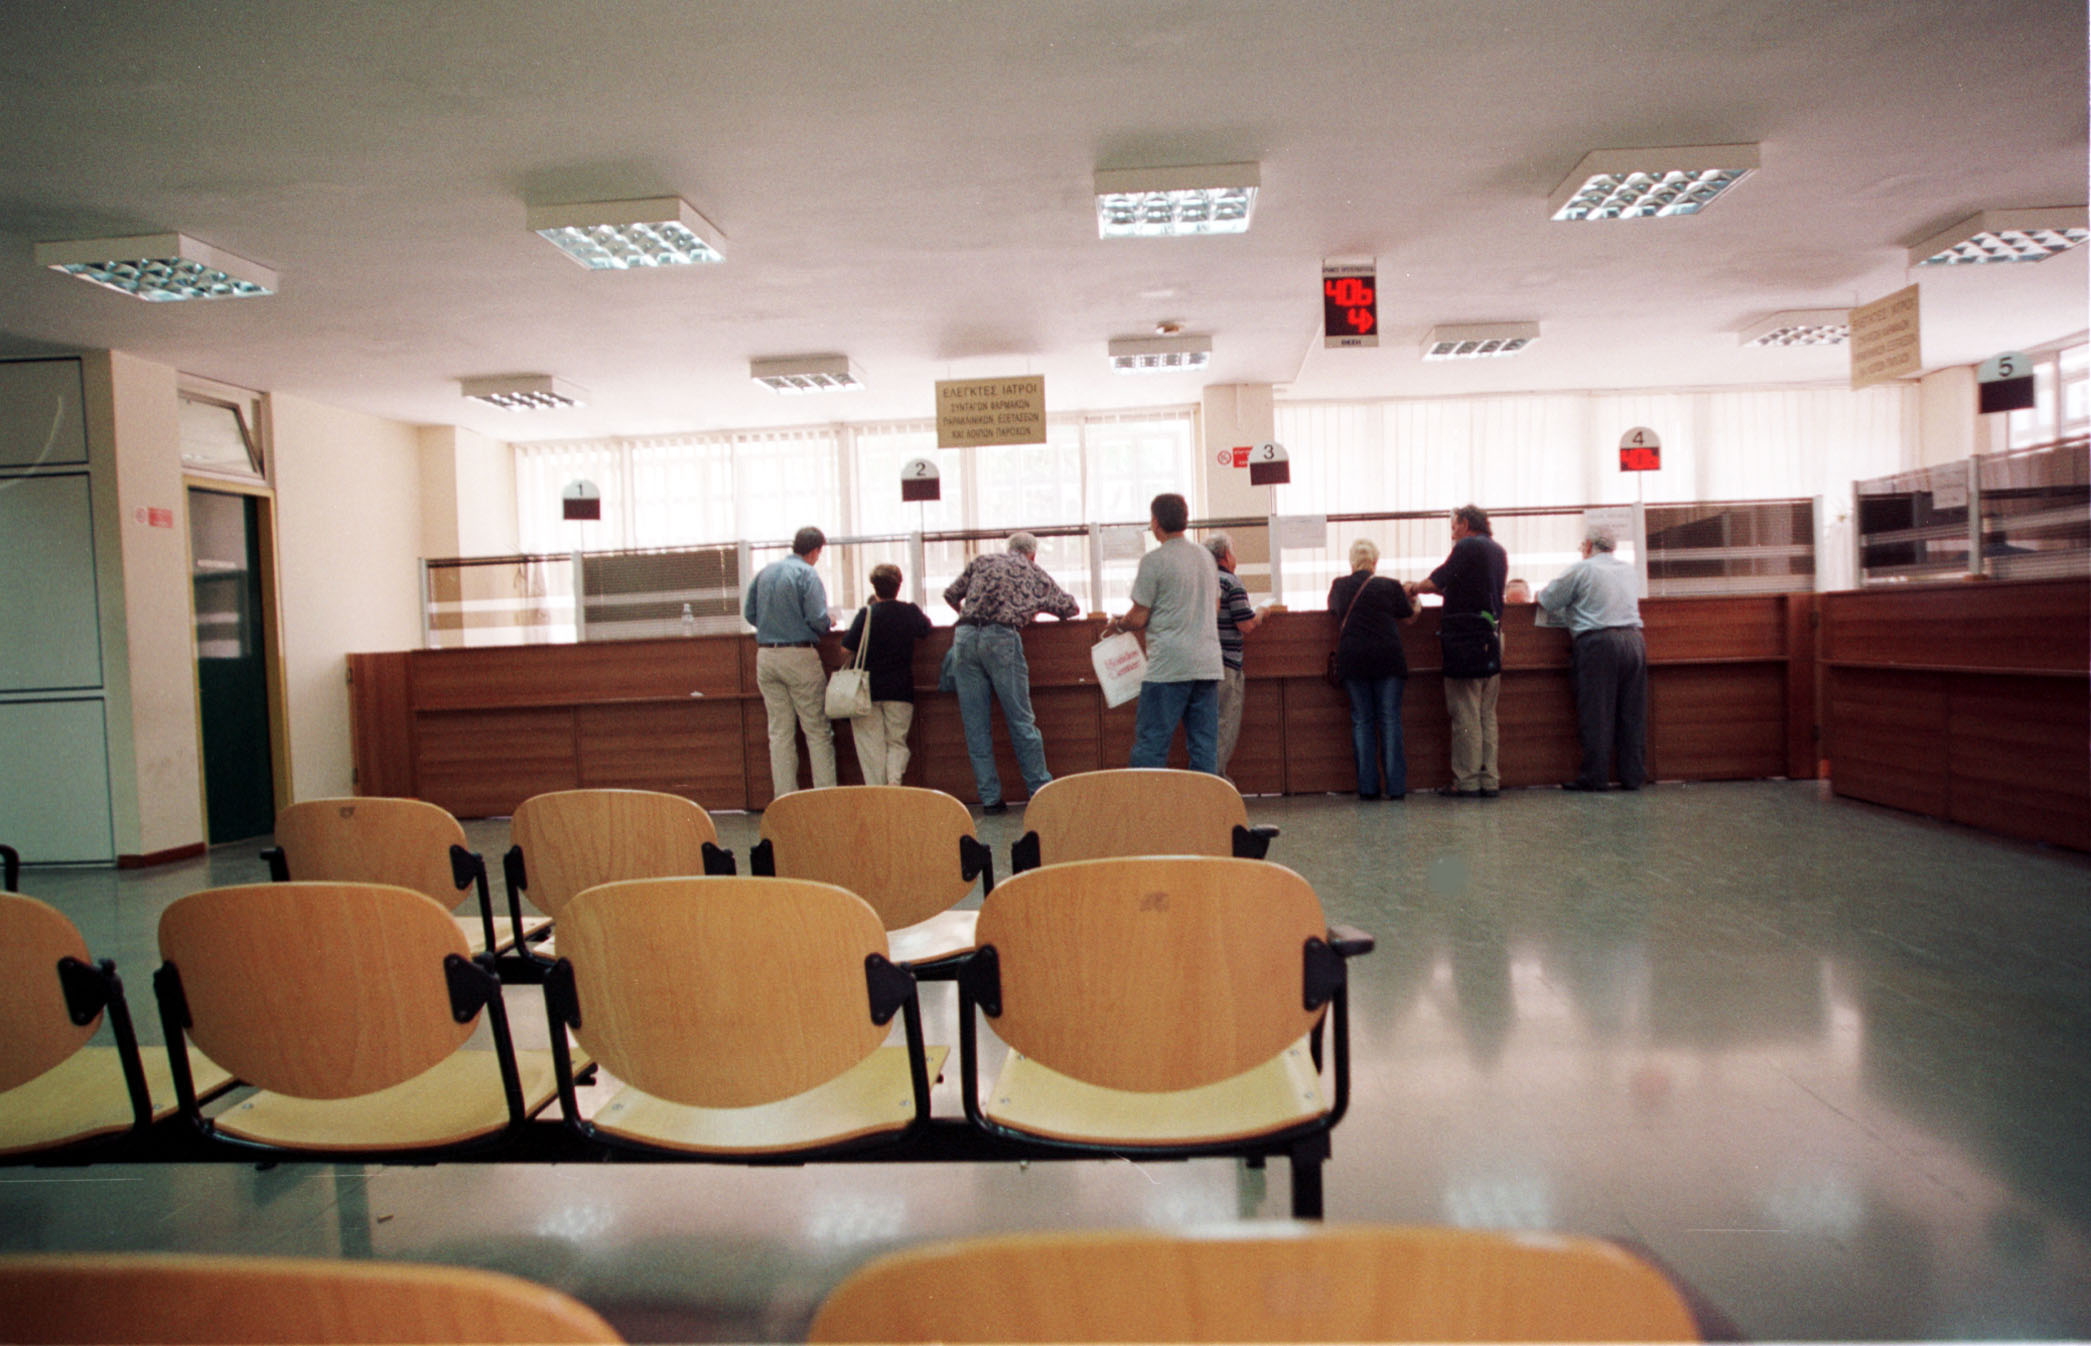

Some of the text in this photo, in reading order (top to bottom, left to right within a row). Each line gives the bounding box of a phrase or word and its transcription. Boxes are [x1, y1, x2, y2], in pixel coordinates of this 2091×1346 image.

[1325, 279, 1374, 306] 406
[1347, 307, 1374, 334] 4
[1999, 356, 2013, 377] 5
[943, 383, 1037, 398] ΕΛΕΓΚΤΕΣ ΙΑΤΡΟΙ
[1632, 431, 1643, 446] 4
[1264, 444, 1275, 460] 3
[915, 461, 927, 477] 2
